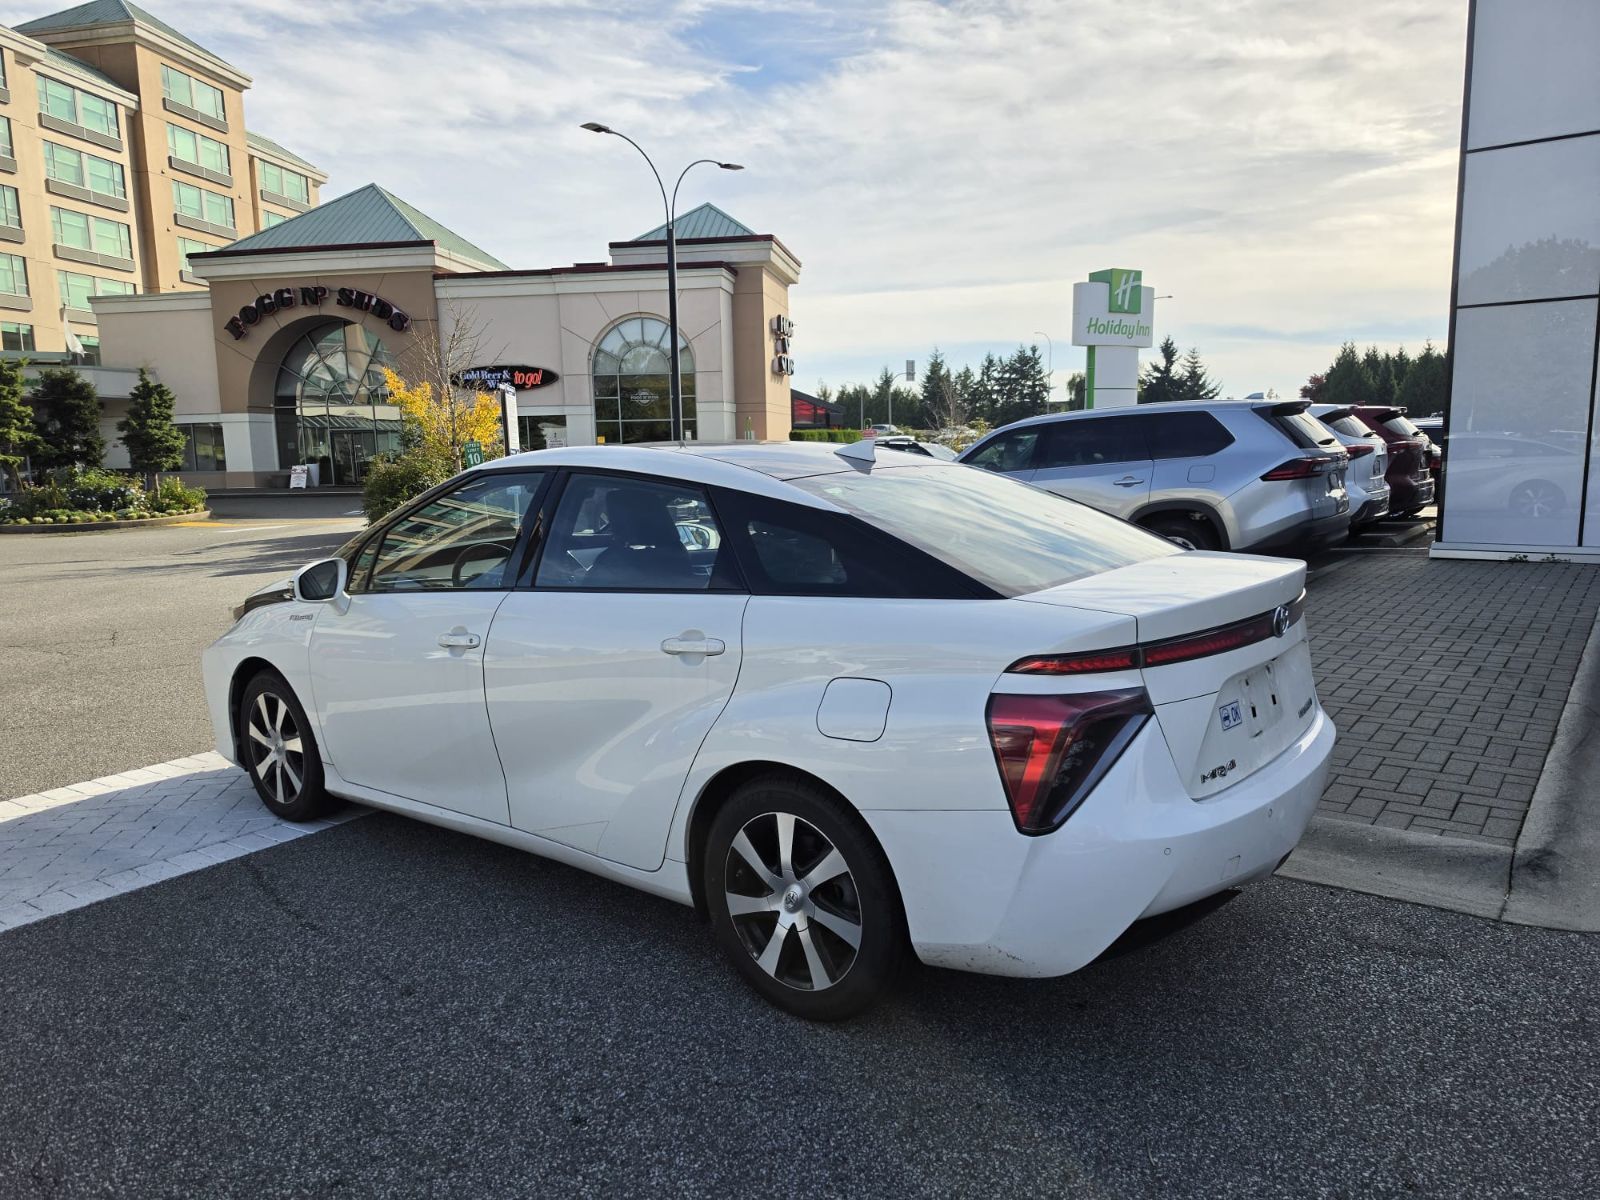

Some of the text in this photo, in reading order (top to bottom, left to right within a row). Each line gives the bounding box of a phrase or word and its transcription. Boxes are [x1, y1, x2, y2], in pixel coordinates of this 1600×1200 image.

[224, 287, 295, 341] FOGG
[1086, 317, 1150, 340] Holiday Inn
[480, 370, 501, 380] Beer
[514, 370, 525, 385] to
[468, 453, 481, 465] 10
[1200, 759, 1236, 784] MIRAI
